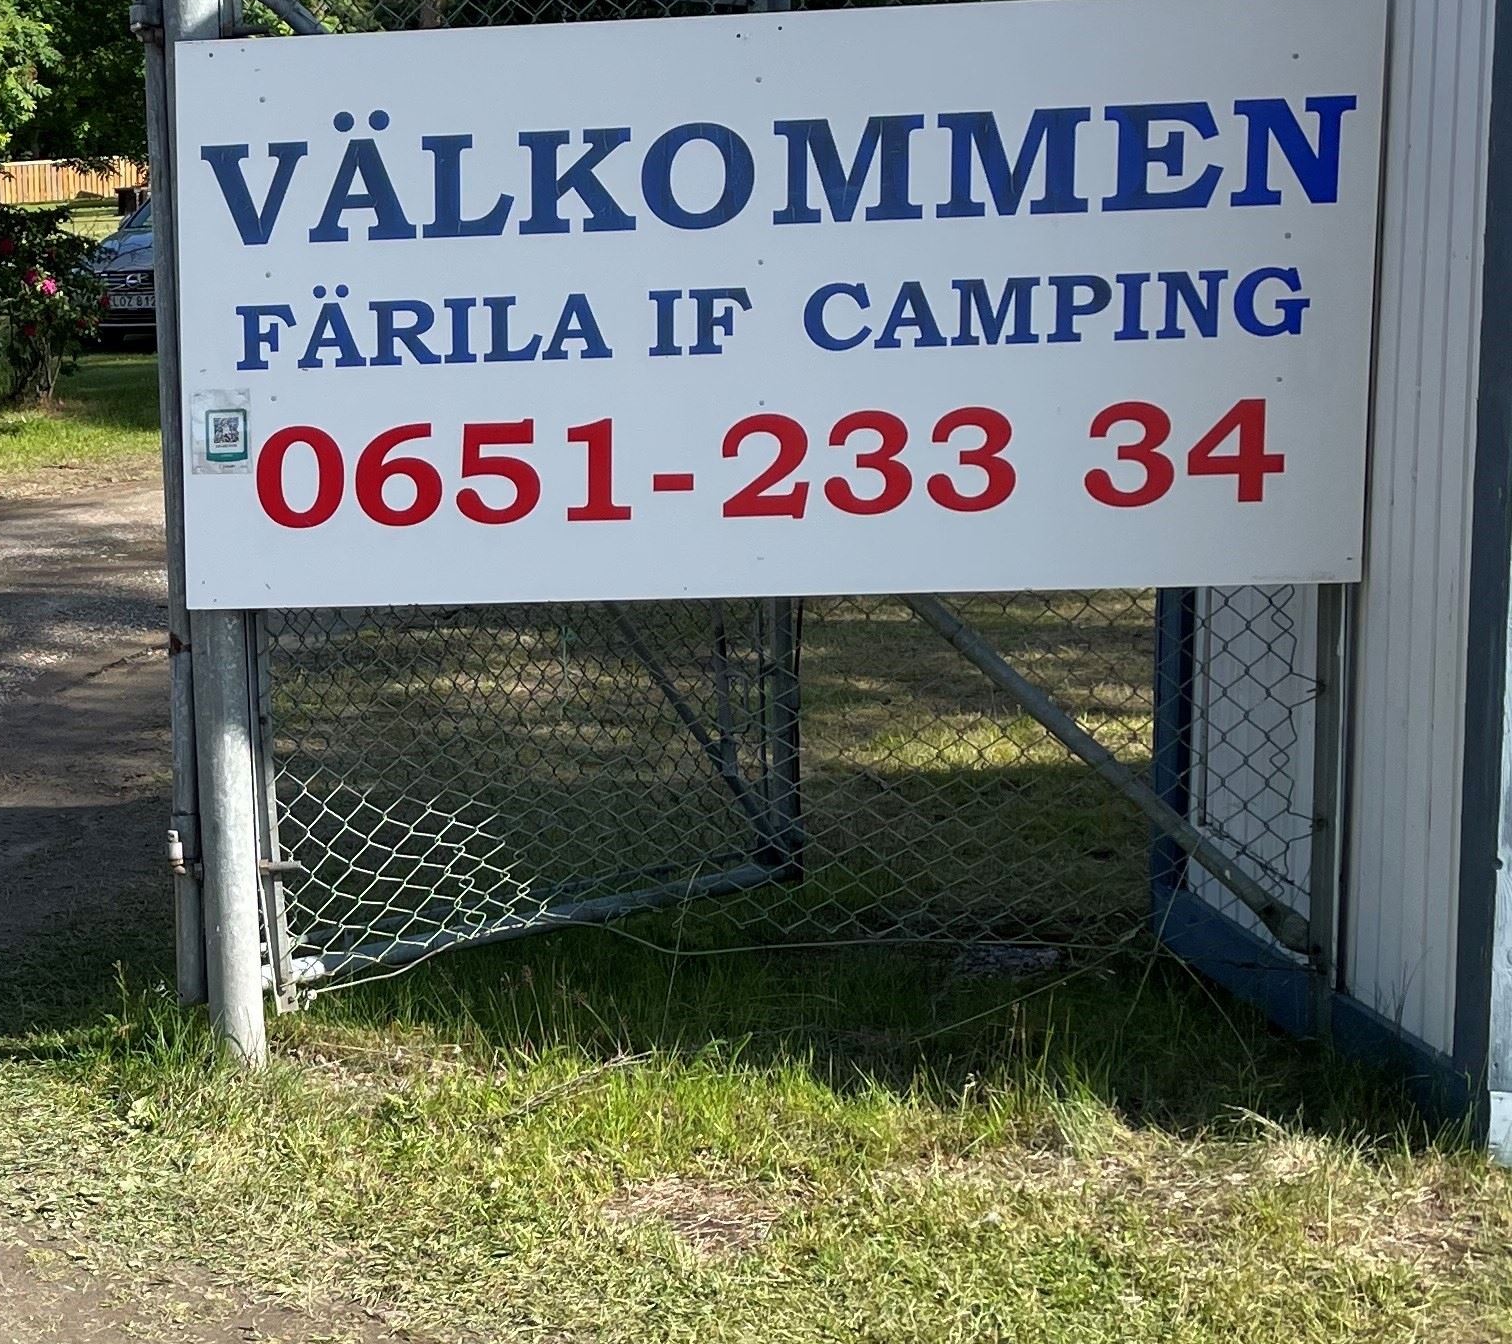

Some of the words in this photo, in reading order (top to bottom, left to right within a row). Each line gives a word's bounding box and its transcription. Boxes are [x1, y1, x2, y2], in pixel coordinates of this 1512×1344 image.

[200, 94, 1357, 246] VÄLKOMMEN
[235, 282, 613, 371] FÄRILA
[648, 287, 753, 357] IF
[803, 267, 1311, 352] CAMPING
[256, 407, 1016, 529] 0651-233
[1084, 399, 1285, 508] 34
